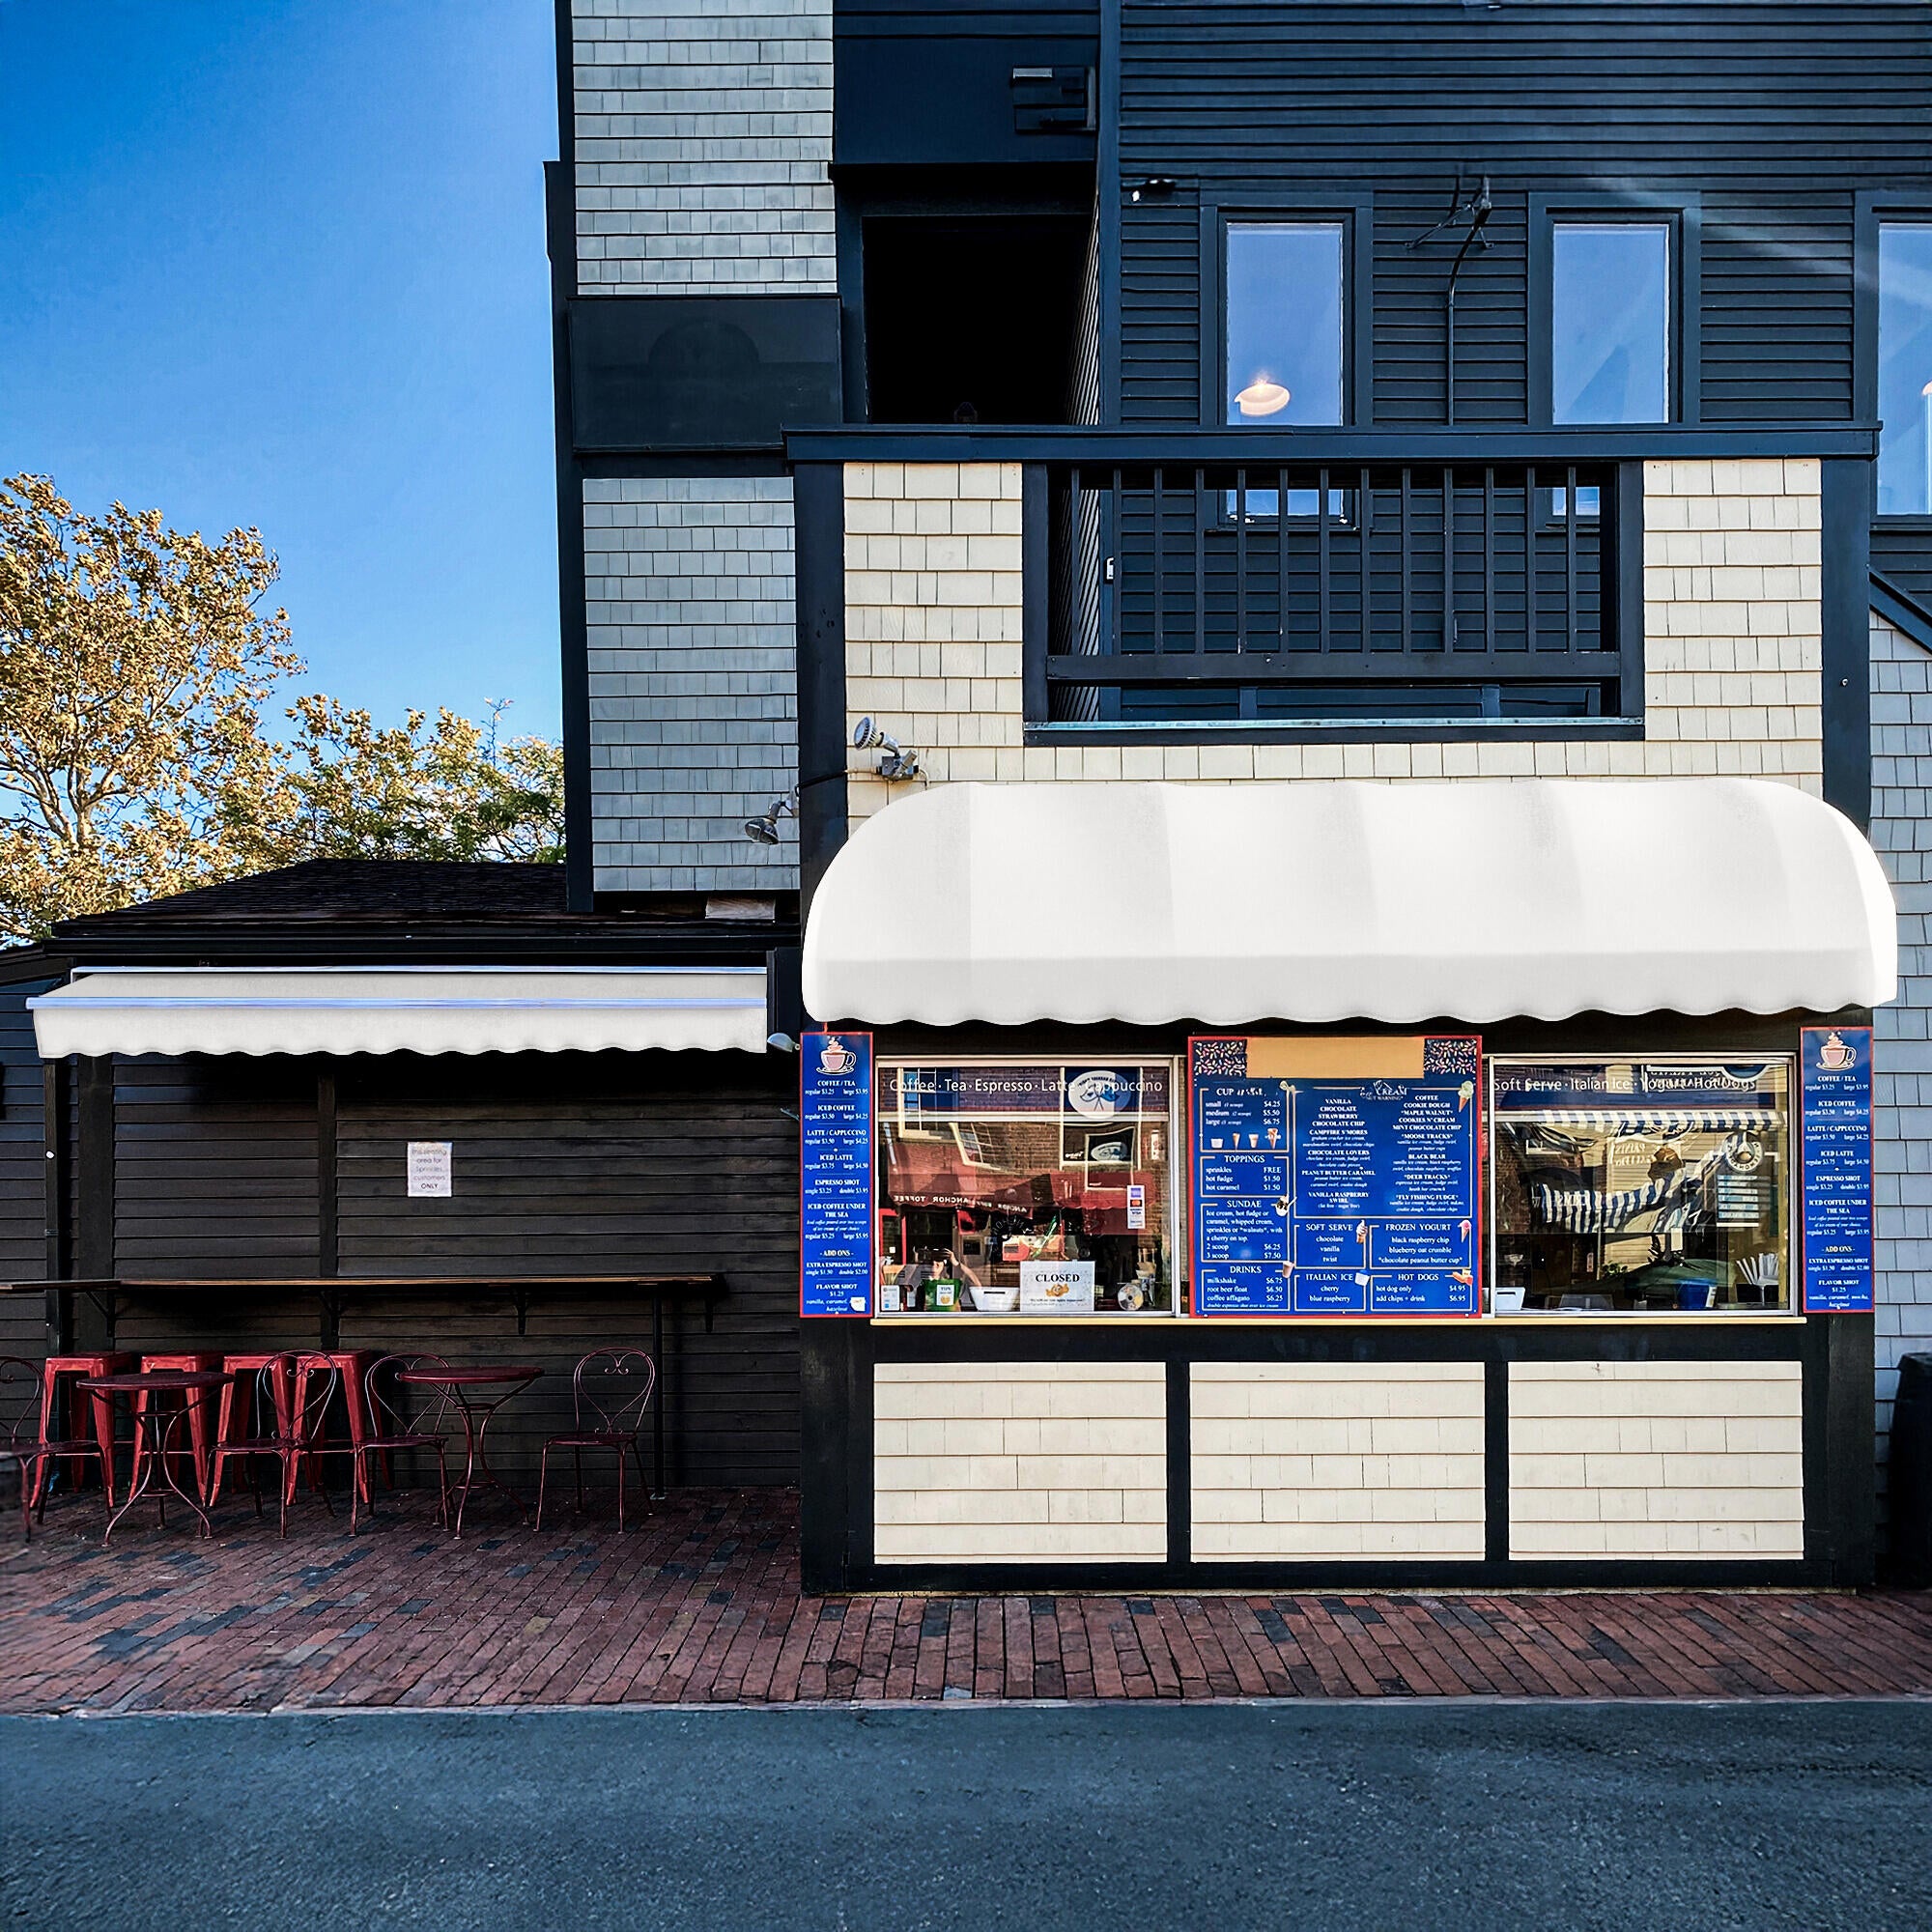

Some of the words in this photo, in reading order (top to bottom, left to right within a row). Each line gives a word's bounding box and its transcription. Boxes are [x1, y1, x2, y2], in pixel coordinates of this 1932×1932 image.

[890, 1078, 935, 1092] Coffee
[944, 1078, 967, 1092] Tea
[975, 1078, 1033, 1094] Espresso
[1041, 1078, 1075, 1092] Latte
[1086, 1078, 1163, 1095] Cappuccino
[1494, 1077, 1520, 1091] Soft
[1525, 1077, 1562, 1091] Serve
[1570, 1077, 1609, 1091] Italian
[1613, 1077, 1631, 1091] Ice
[1216, 1088, 1235, 1096] CUP
[1224, 1154, 1265, 1163] TOPPINGS
[1216, 1175, 1234, 1183] fudge
[1245, 1209, 1262, 1218] fudge
[1385, 1223, 1416, 1232] FROZEN
[1419, 1223, 1452, 1232] YOGURT
[1229, 1265, 1263, 1274] DRINKS
[1036, 1273, 1080, 1283] CLOSED
[1387, 1294, 1404, 1303] chips
